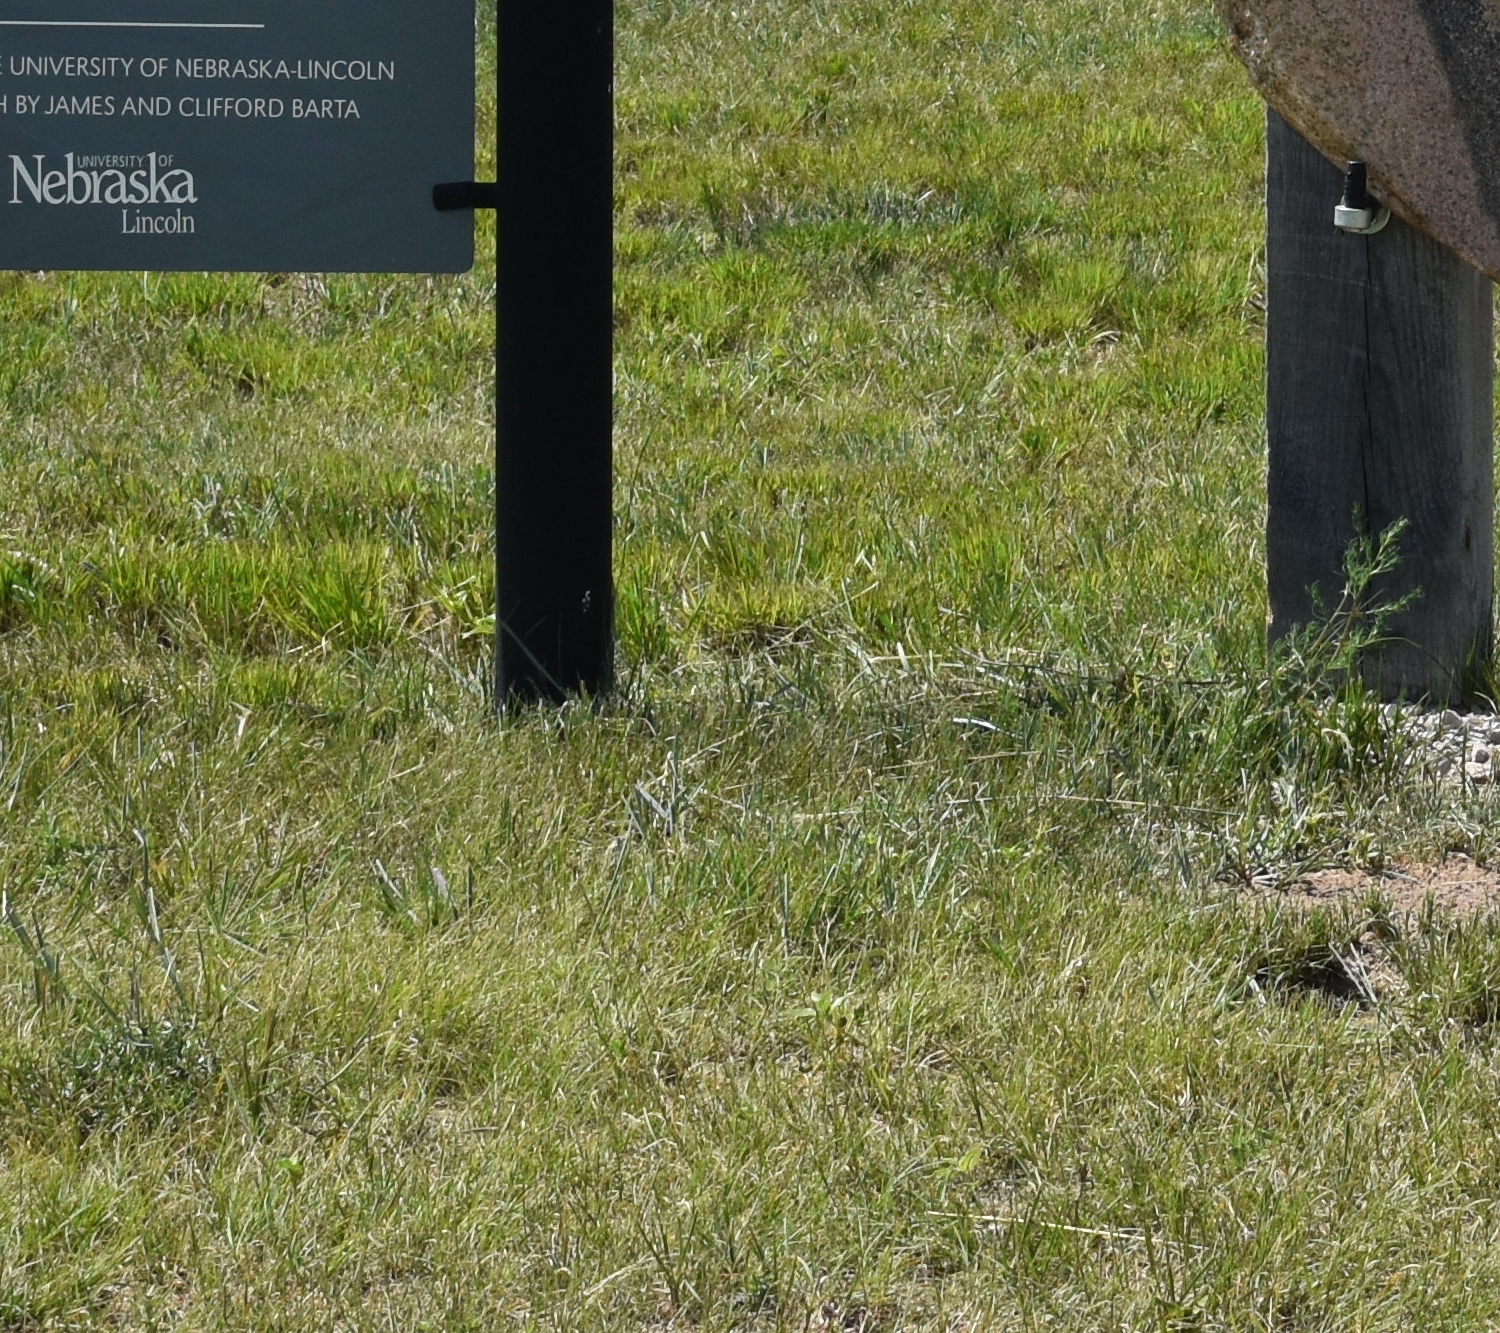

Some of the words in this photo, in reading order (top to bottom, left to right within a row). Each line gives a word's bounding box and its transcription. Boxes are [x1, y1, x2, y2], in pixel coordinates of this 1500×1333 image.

[10, 55, 134, 77] UNIVERSITY
[139, 57, 169, 78] OF
[175, 58, 395, 81] NEBRASKA-LINCOLN
[15, 94, 41, 114] BY
[44, 95, 115, 116] JAMES
[121, 96, 172, 117] AND
[178, 96, 284, 118] CLIFFORD
[292, 98, 361, 119] BARTA
[76, 154, 144, 168] UNIVERSITY
[158, 154, 174, 168] OF
[8, 151, 198, 205] Nebraska
[121, 207, 195, 234] Lincoln
